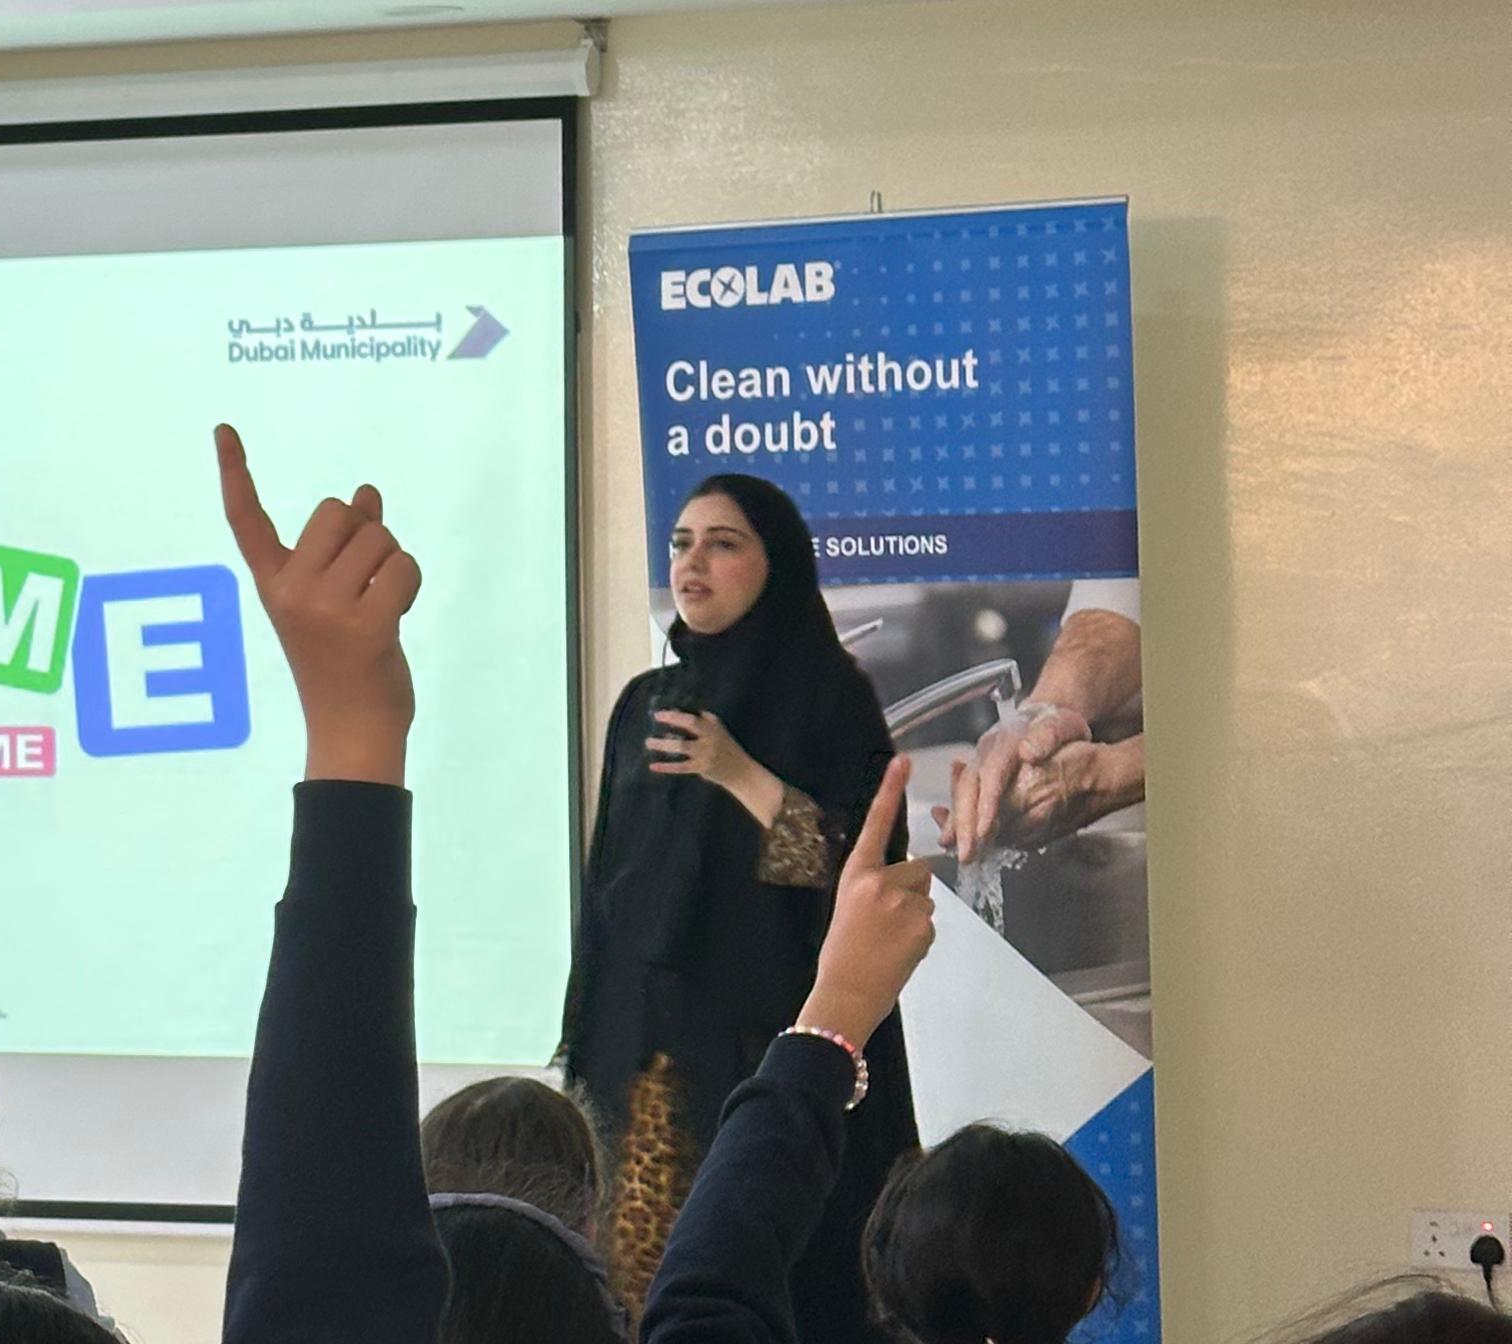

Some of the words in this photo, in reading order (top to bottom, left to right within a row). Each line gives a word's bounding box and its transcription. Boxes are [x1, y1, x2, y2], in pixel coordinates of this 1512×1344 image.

[661, 262, 835, 310] ECOLAB
[228, 339, 295, 362] Dubai
[300, 335, 442, 362] Municipality
[665, 360, 790, 402] Clean
[806, 349, 979, 396] without
[666, 424, 690, 456] a
[705, 411, 836, 454] doubt
[826, 534, 948, 557] SOLUTIONS
